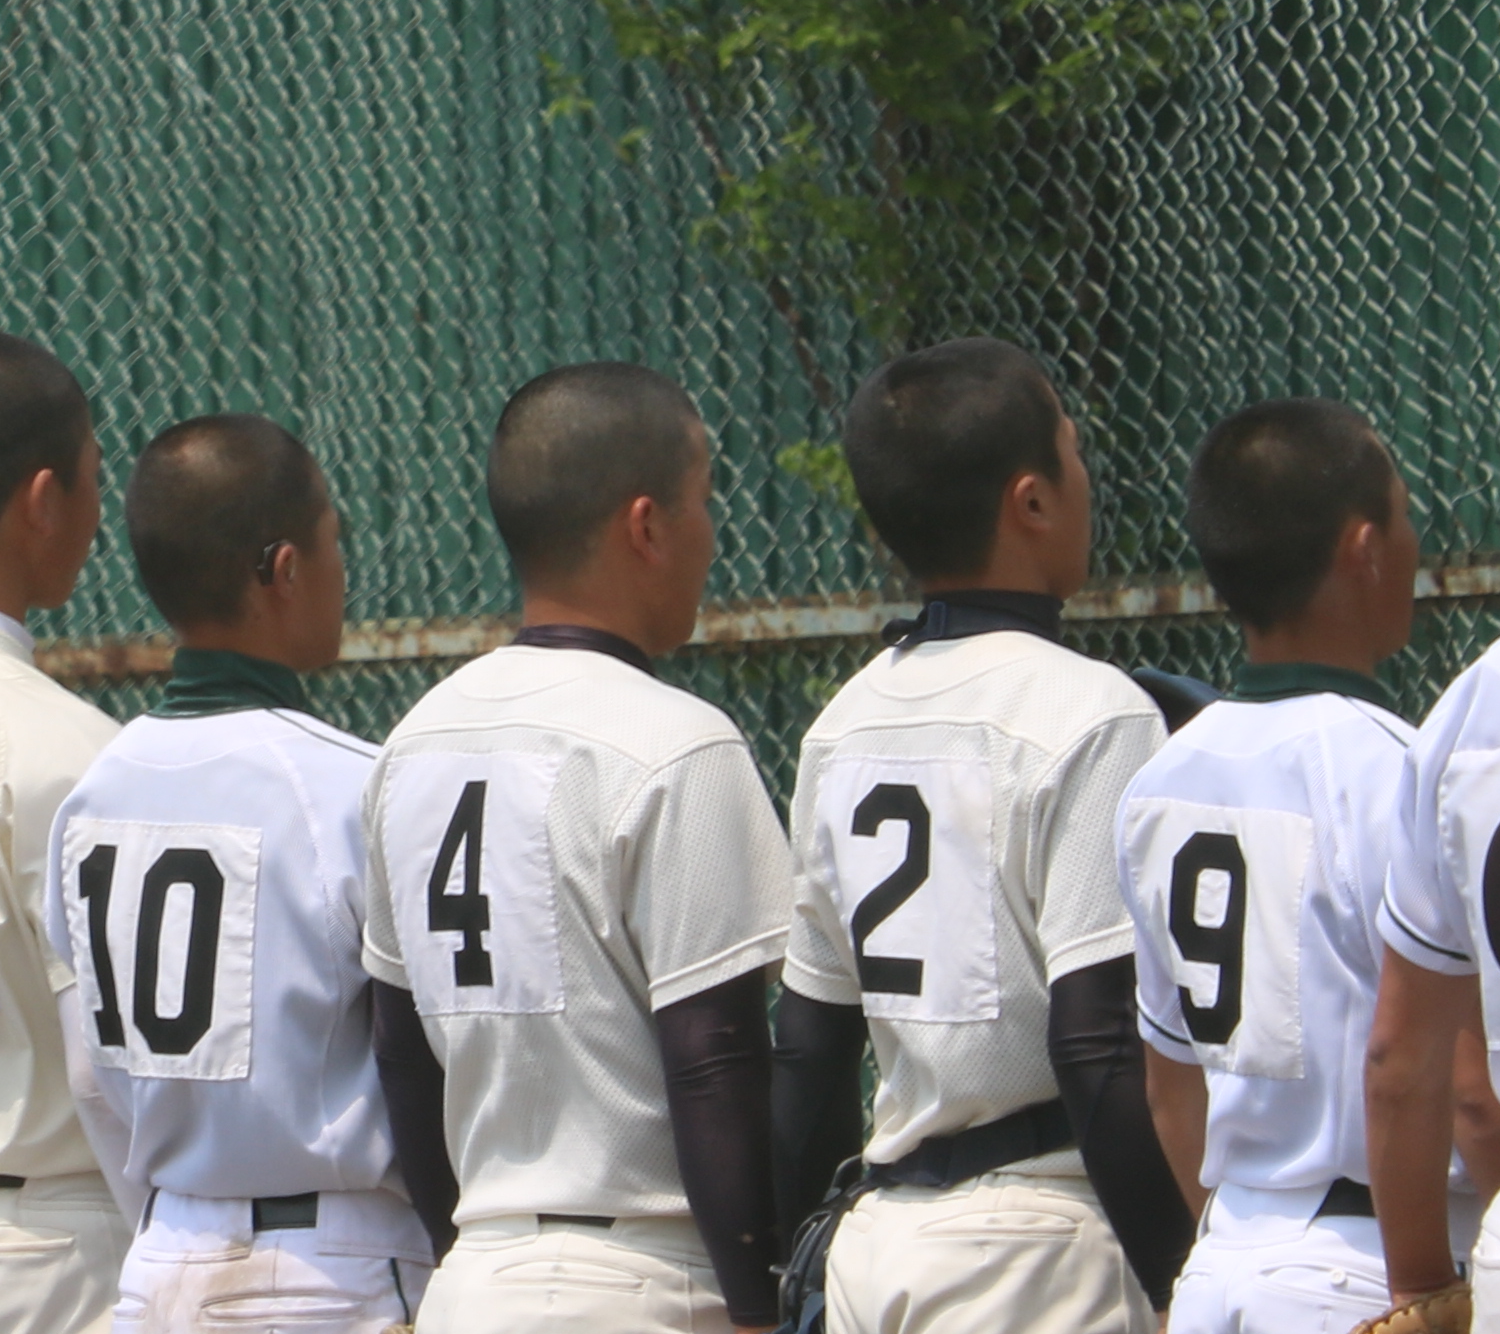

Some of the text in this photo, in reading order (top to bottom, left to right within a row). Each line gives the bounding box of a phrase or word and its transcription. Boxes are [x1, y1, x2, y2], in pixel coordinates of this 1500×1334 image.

[78, 843, 225, 1056] 10
[427, 780, 493, 988] 4
[850, 782, 930, 996] 2
[1168, 831, 1247, 1046] 9
